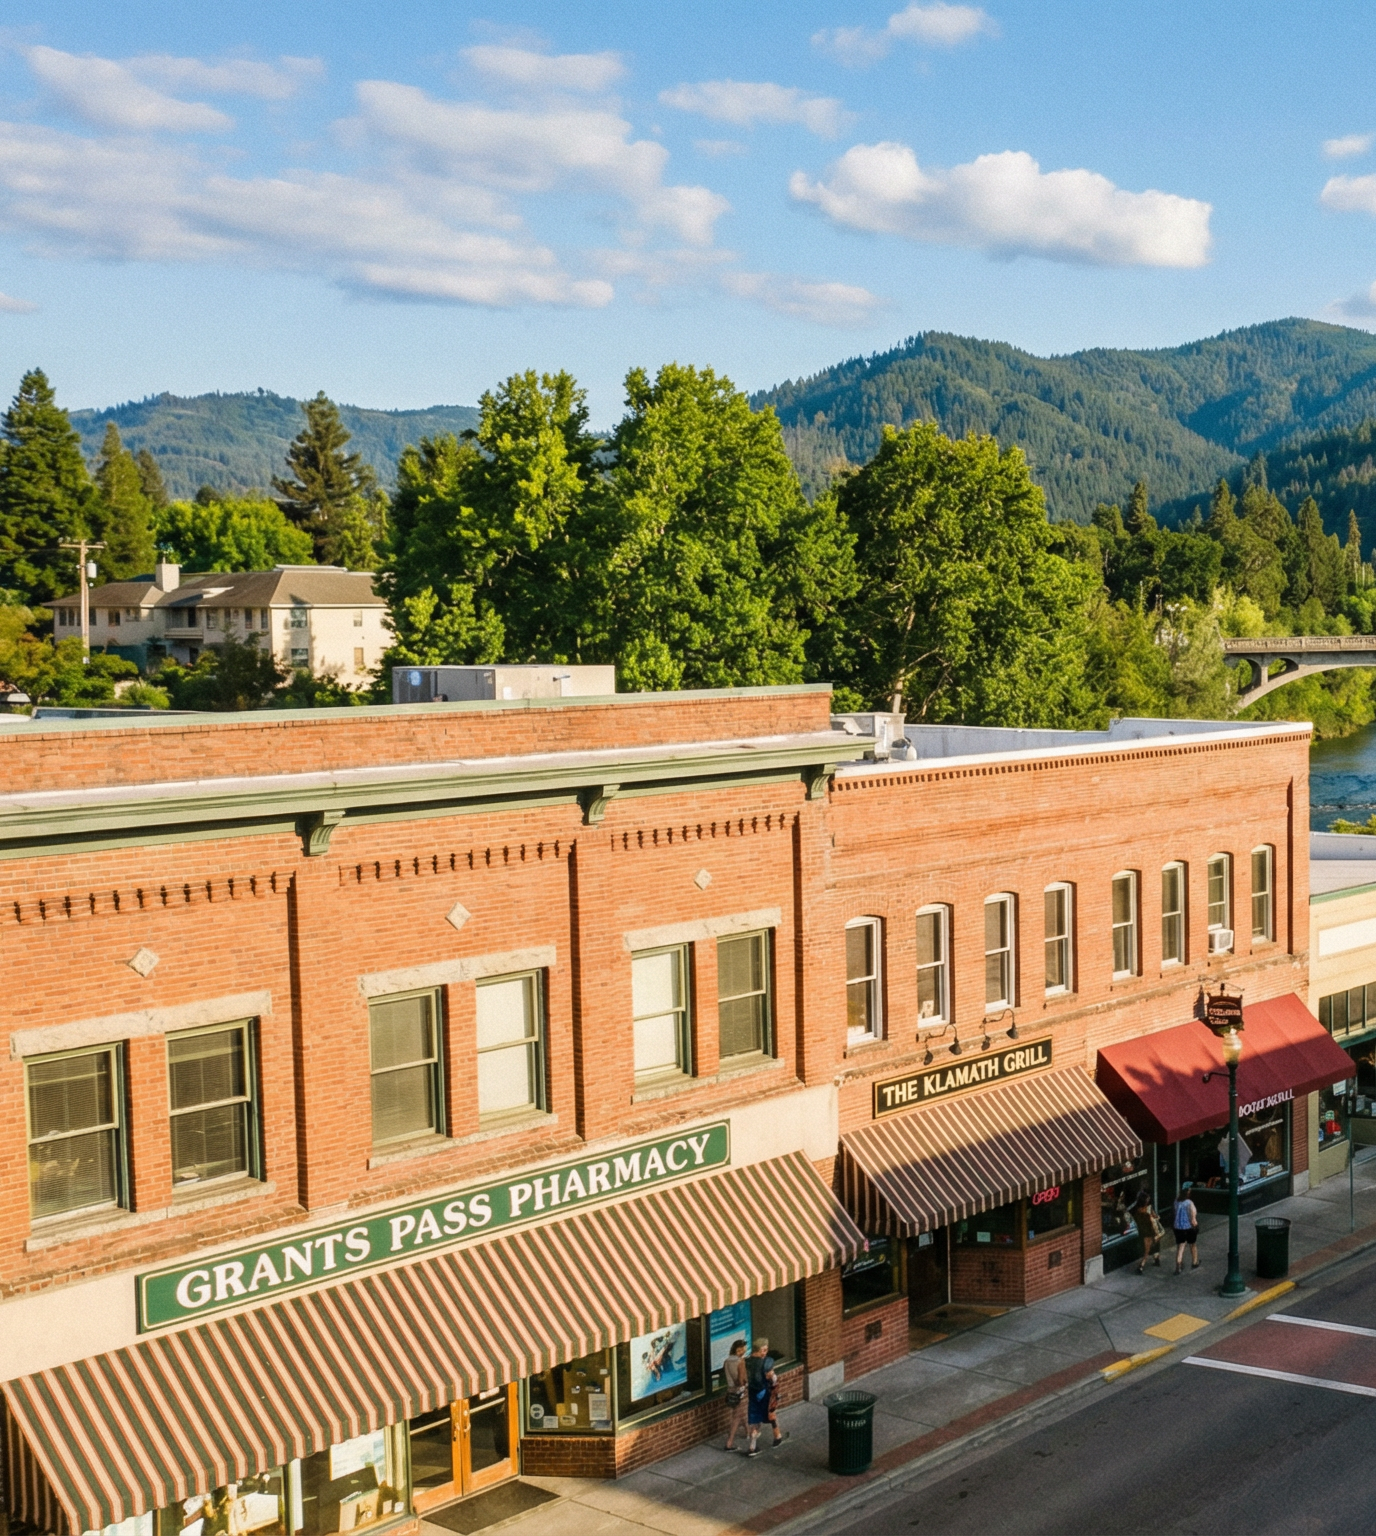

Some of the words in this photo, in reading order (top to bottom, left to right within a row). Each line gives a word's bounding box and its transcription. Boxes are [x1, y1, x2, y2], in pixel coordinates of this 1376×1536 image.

[882, 1080, 918, 1106] THE
[923, 1058, 999, 1096] KLAMATH
[1004, 1046, 1048, 1073] GRILL
[175, 1226, 371, 1309] GRANTS
[388, 1193, 493, 1252] PASS
[508, 1133, 711, 1218] PHARMACY
